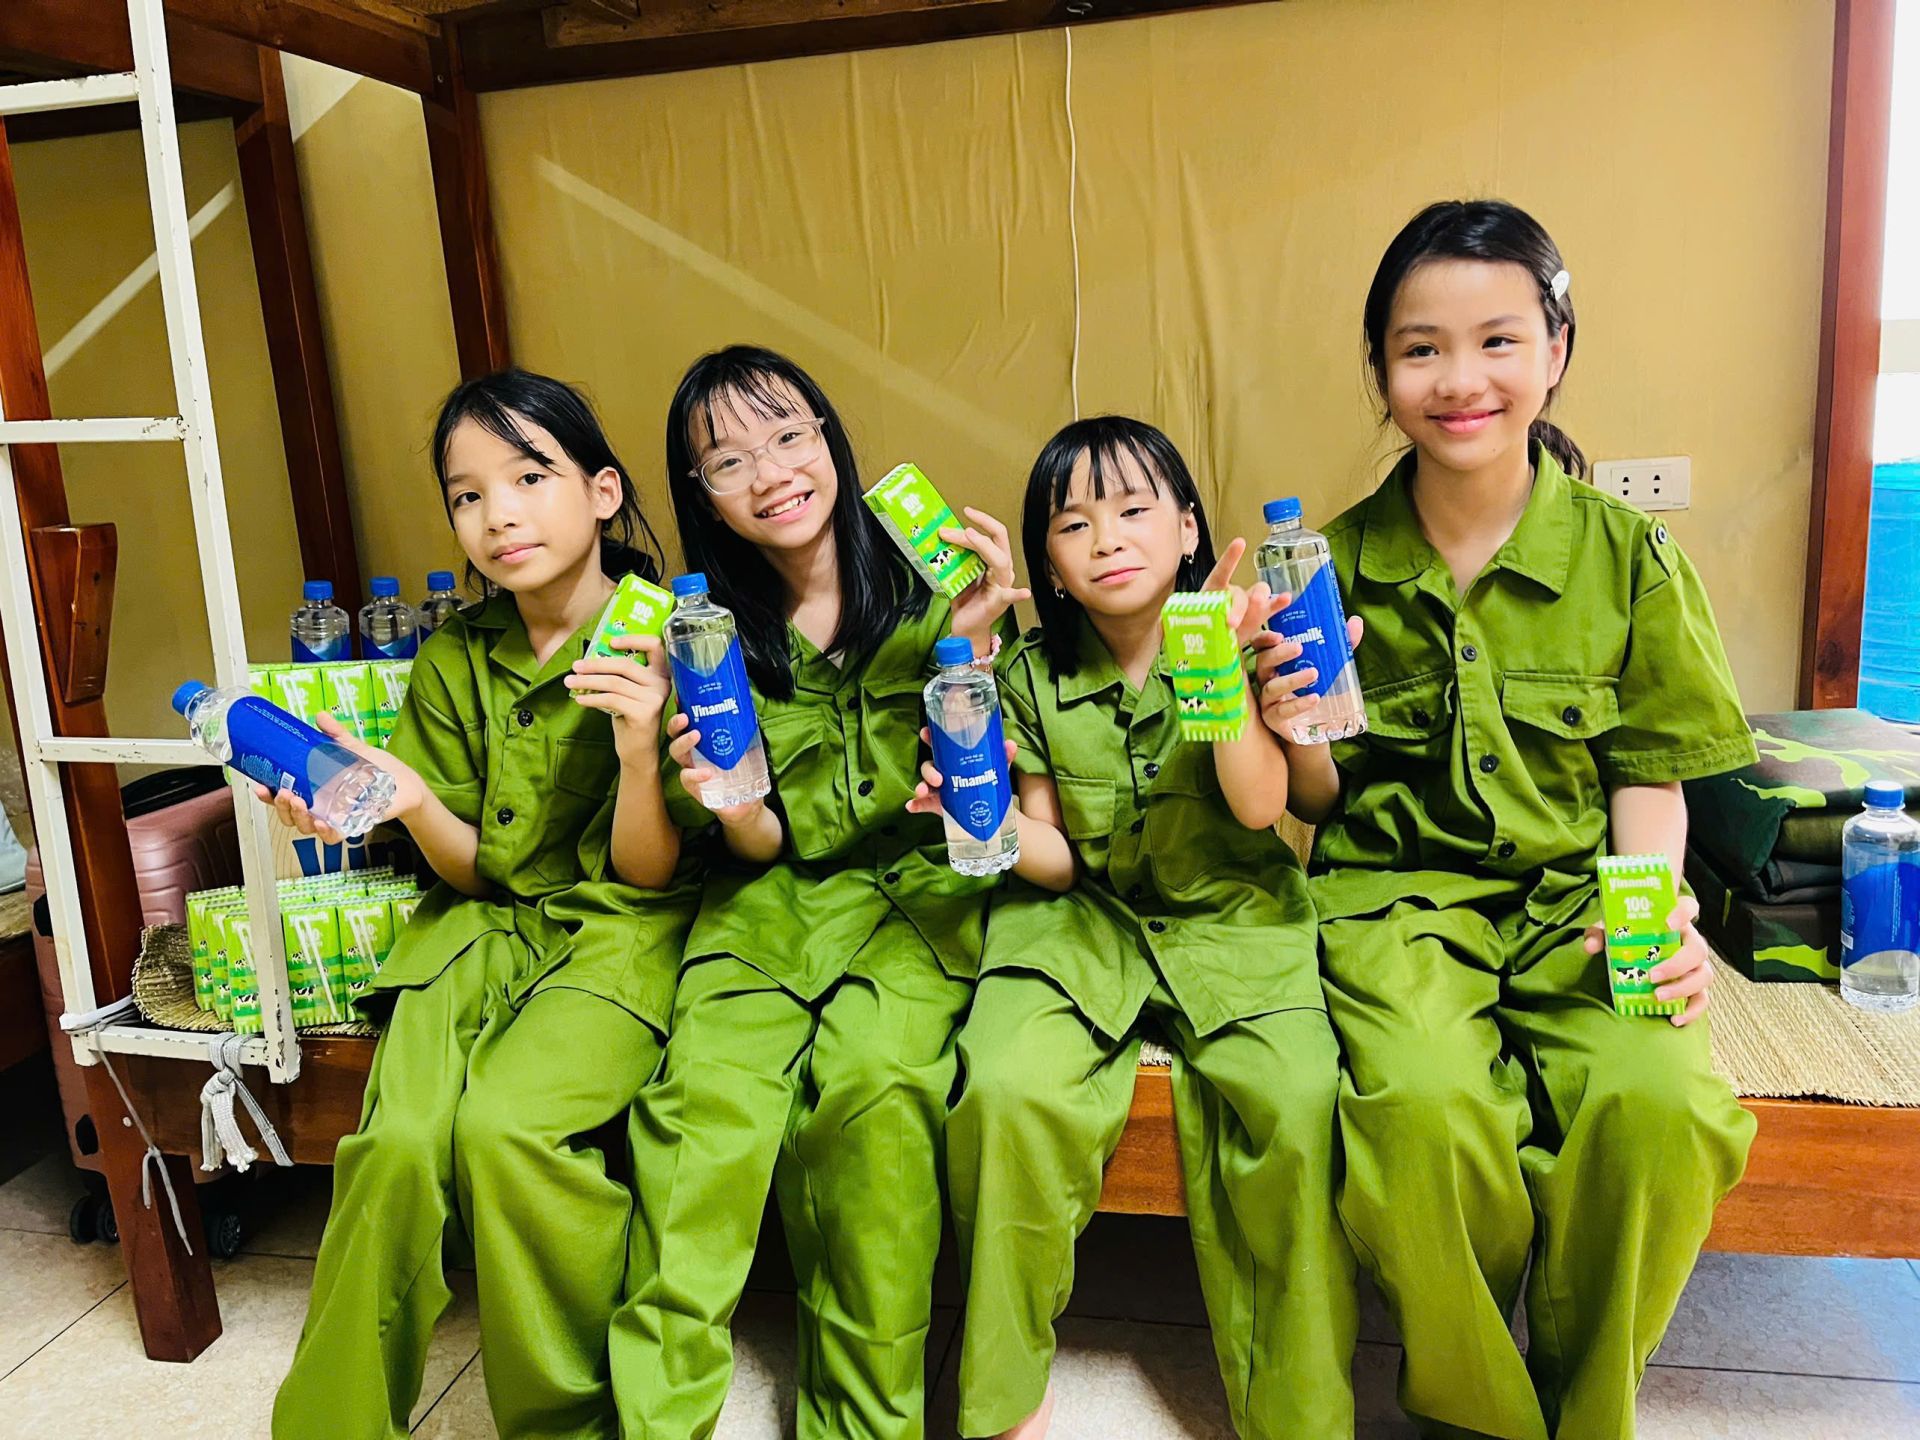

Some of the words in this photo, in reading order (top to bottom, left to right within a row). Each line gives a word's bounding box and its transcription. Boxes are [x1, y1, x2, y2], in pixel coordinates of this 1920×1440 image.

[1284, 626, 1324, 644] namilk
[691, 697, 738, 718] Vinamilk
[951, 769, 998, 788] Vinamilk
